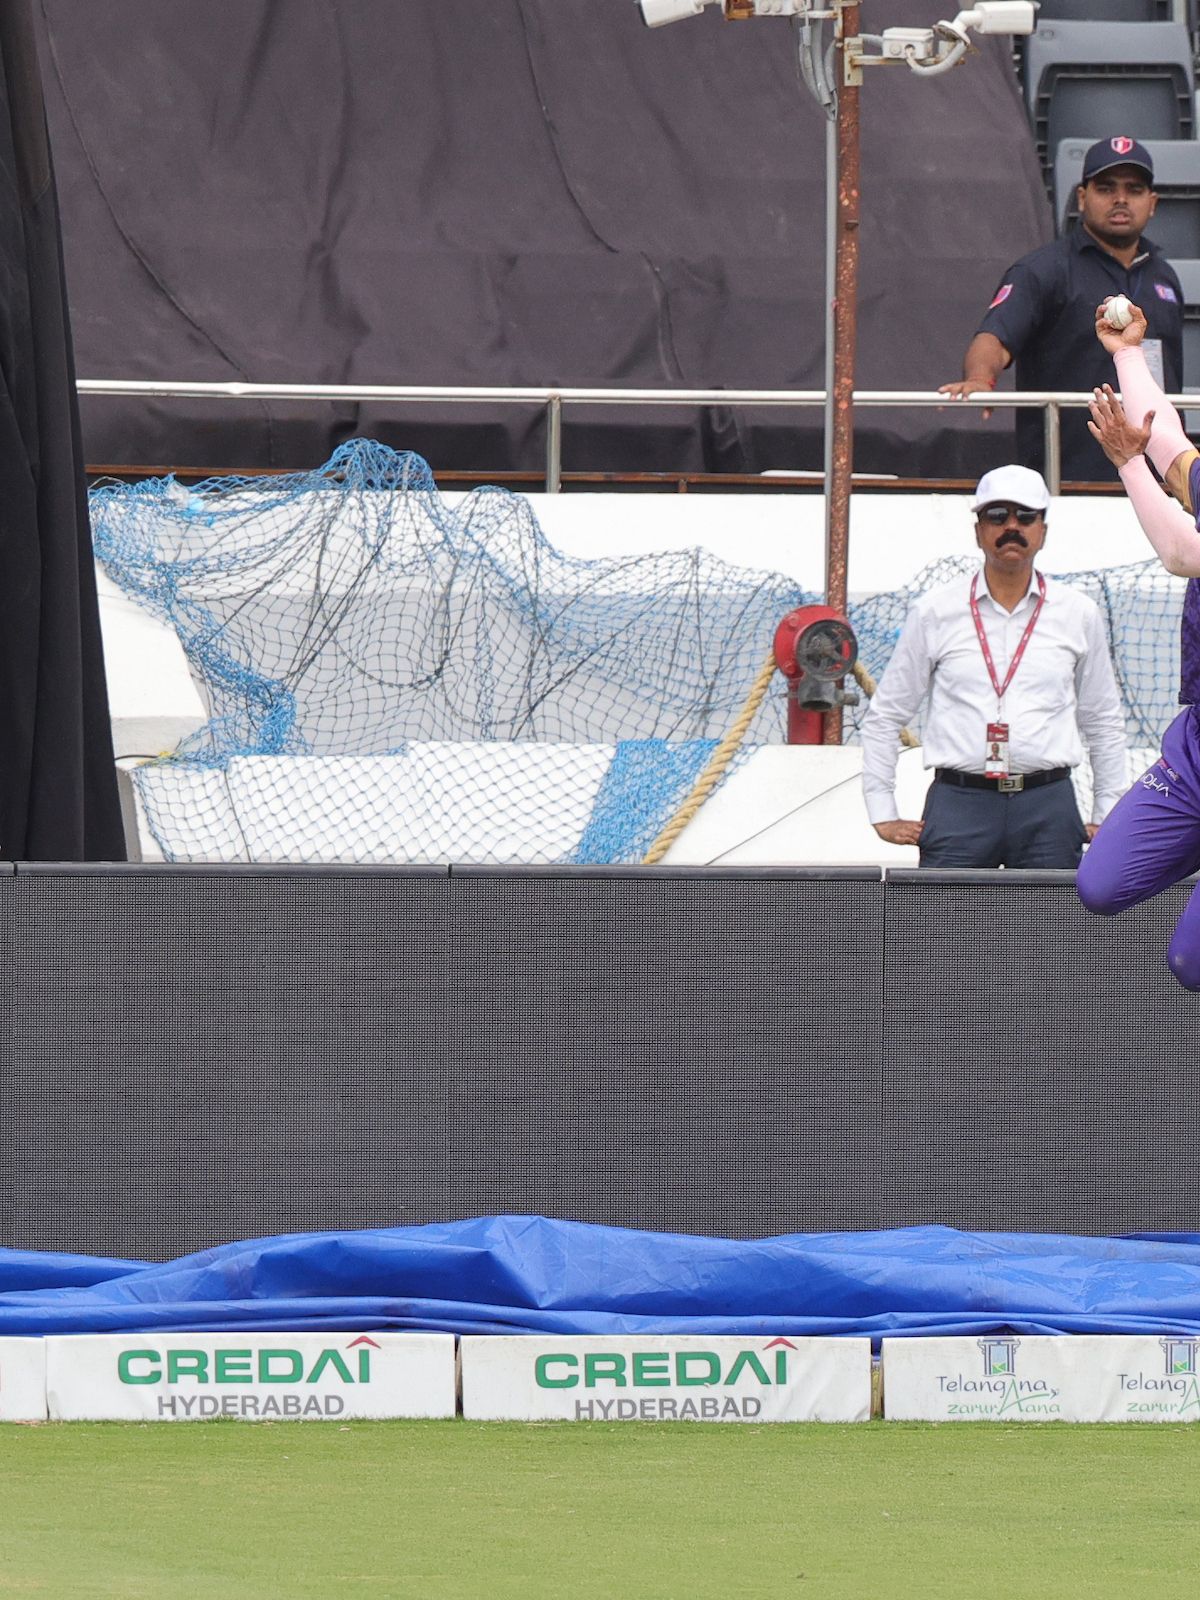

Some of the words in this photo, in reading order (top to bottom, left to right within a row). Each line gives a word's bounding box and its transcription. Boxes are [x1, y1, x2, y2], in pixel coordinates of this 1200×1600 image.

[117, 1346, 372, 1385] CREDAI
[535, 1349, 788, 1389] CREDAI
[157, 1394, 345, 1418] HYDERABAD
[575, 1396, 762, 1420] HYDERABAD
